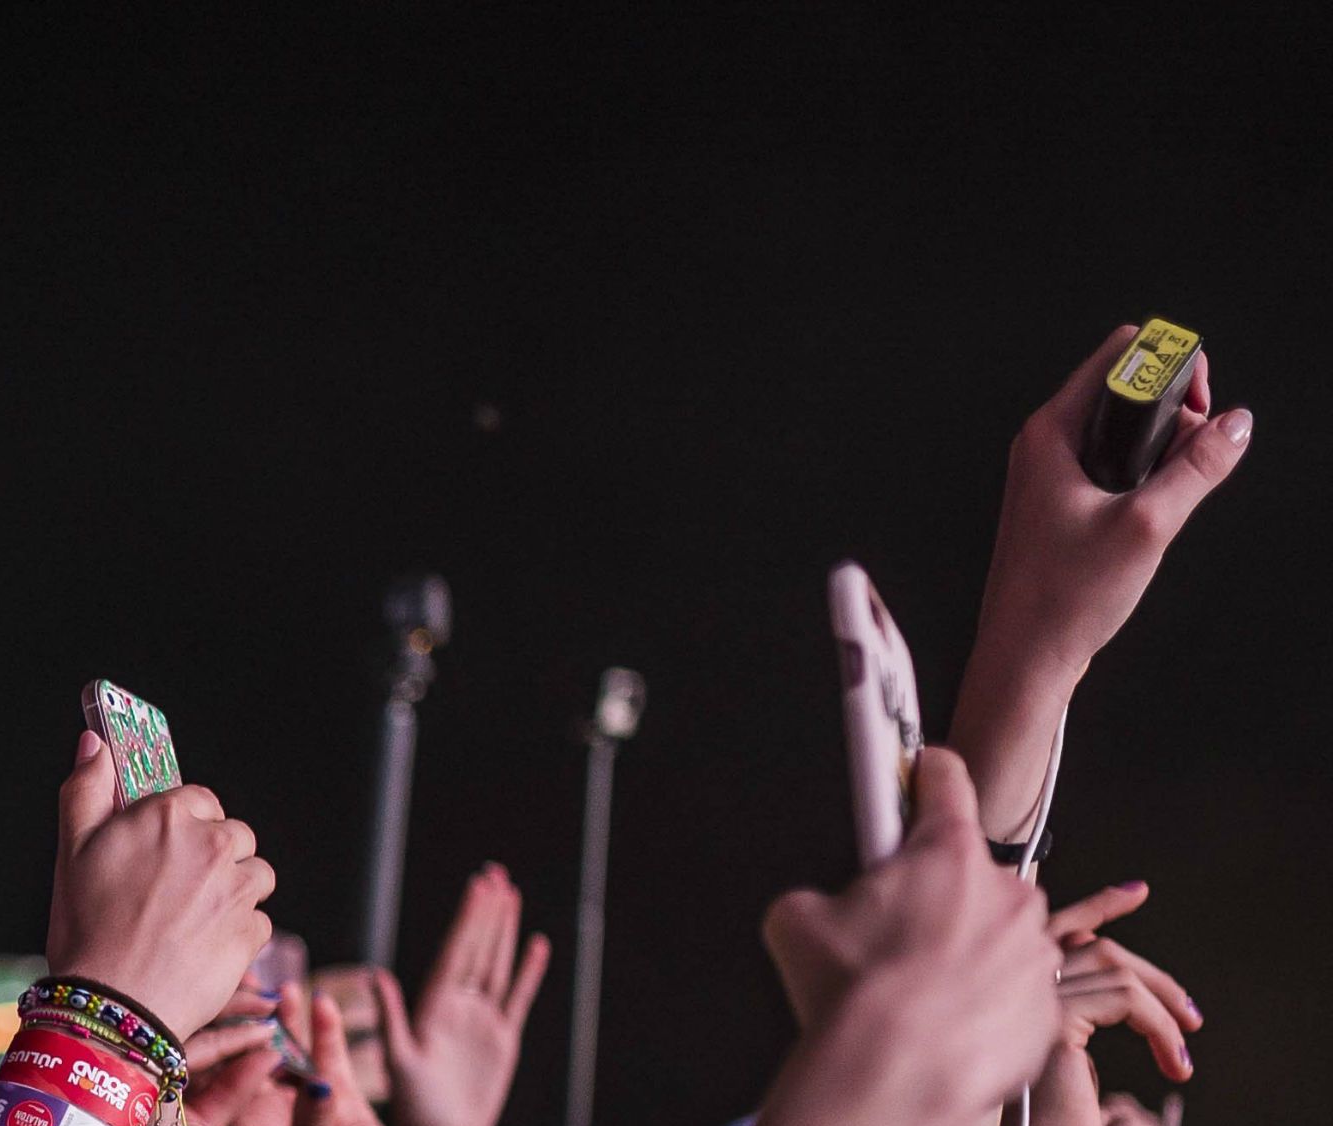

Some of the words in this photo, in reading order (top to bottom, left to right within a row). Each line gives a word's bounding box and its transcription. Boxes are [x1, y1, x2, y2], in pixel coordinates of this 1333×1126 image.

[7, 1050, 63, 1069] JÚLIUS
[67, 1072, 127, 1111] BALATON
[72, 1060, 131, 1101] SOUND
